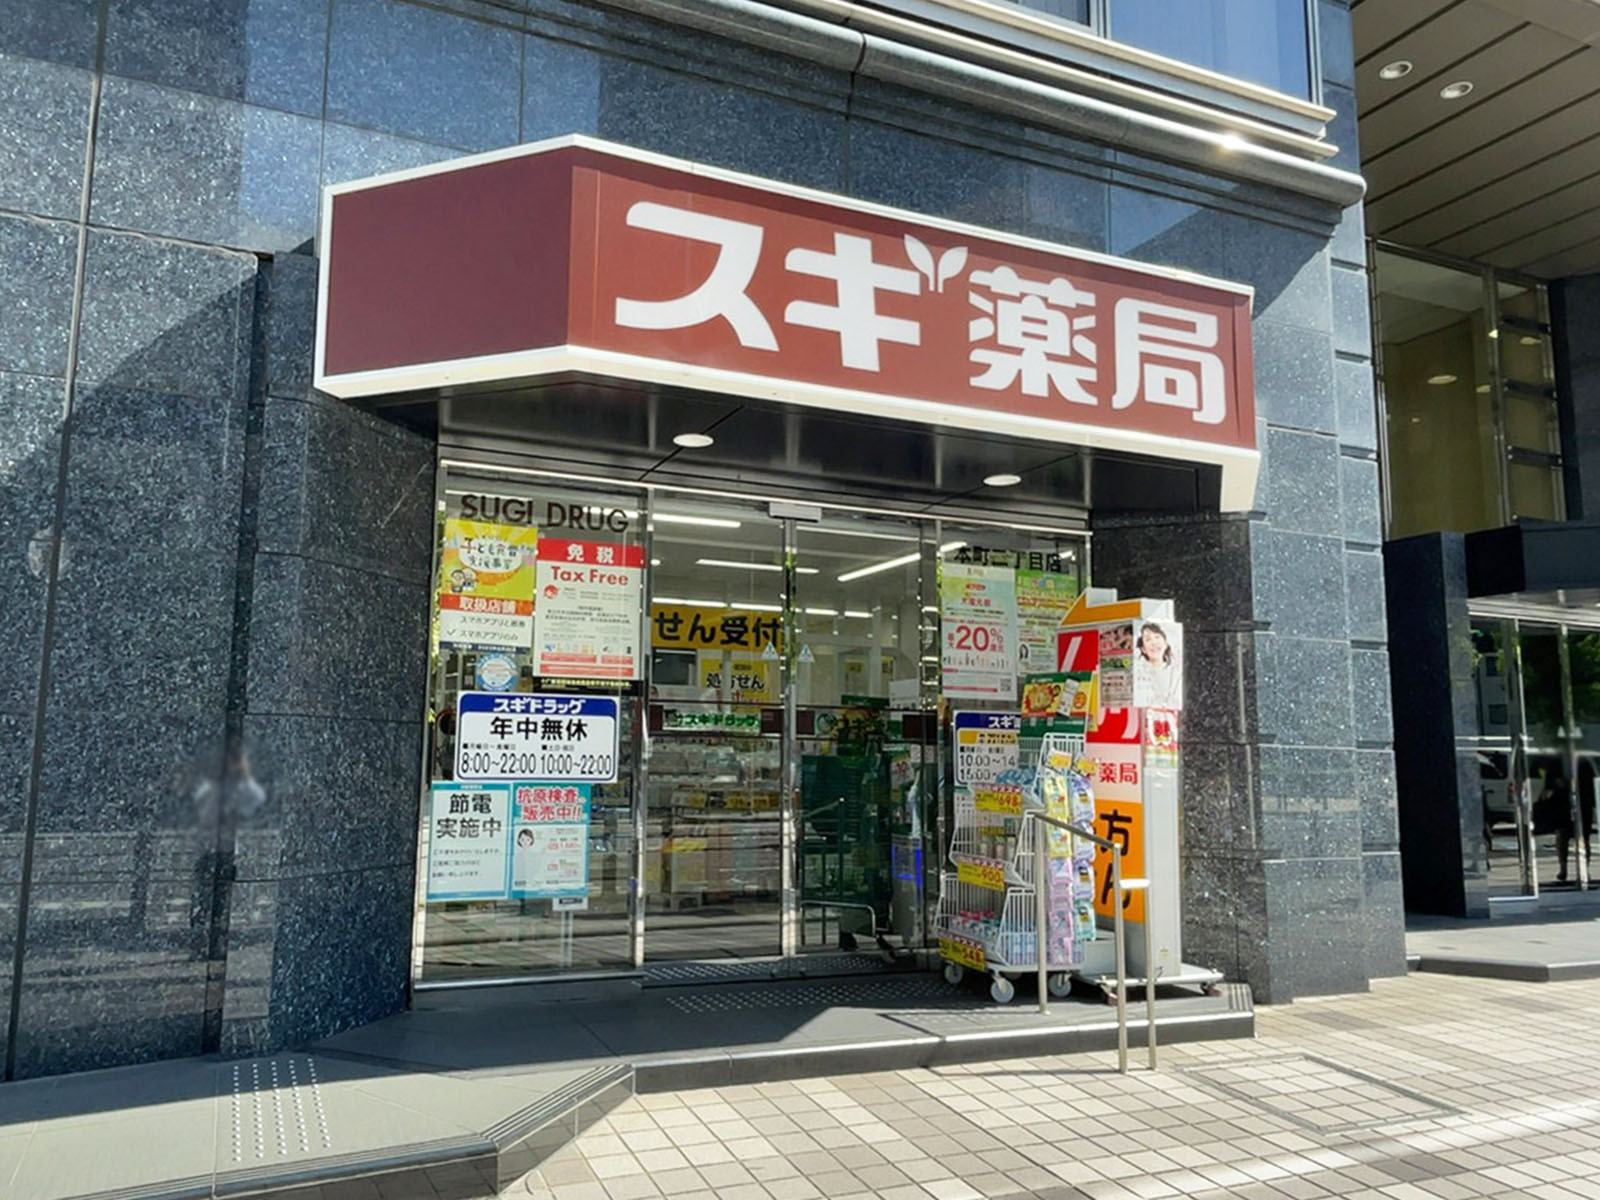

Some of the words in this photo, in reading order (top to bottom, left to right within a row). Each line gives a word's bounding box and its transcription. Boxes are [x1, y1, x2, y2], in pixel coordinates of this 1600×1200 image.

[615, 200, 1227, 425] スギ薬局
[460, 493, 534, 525] SUGI
[547, 501, 629, 533] DRUG
[566, 543, 614, 564] 免税
[551, 565, 584, 583] Tax
[589, 568, 629, 585] Free
[493, 698, 586, 715] スギドラッグ
[490, 716, 588, 741] 年中無休
[449, 793, 492, 814] 節電
[436, 817, 501, 839] 実施中
